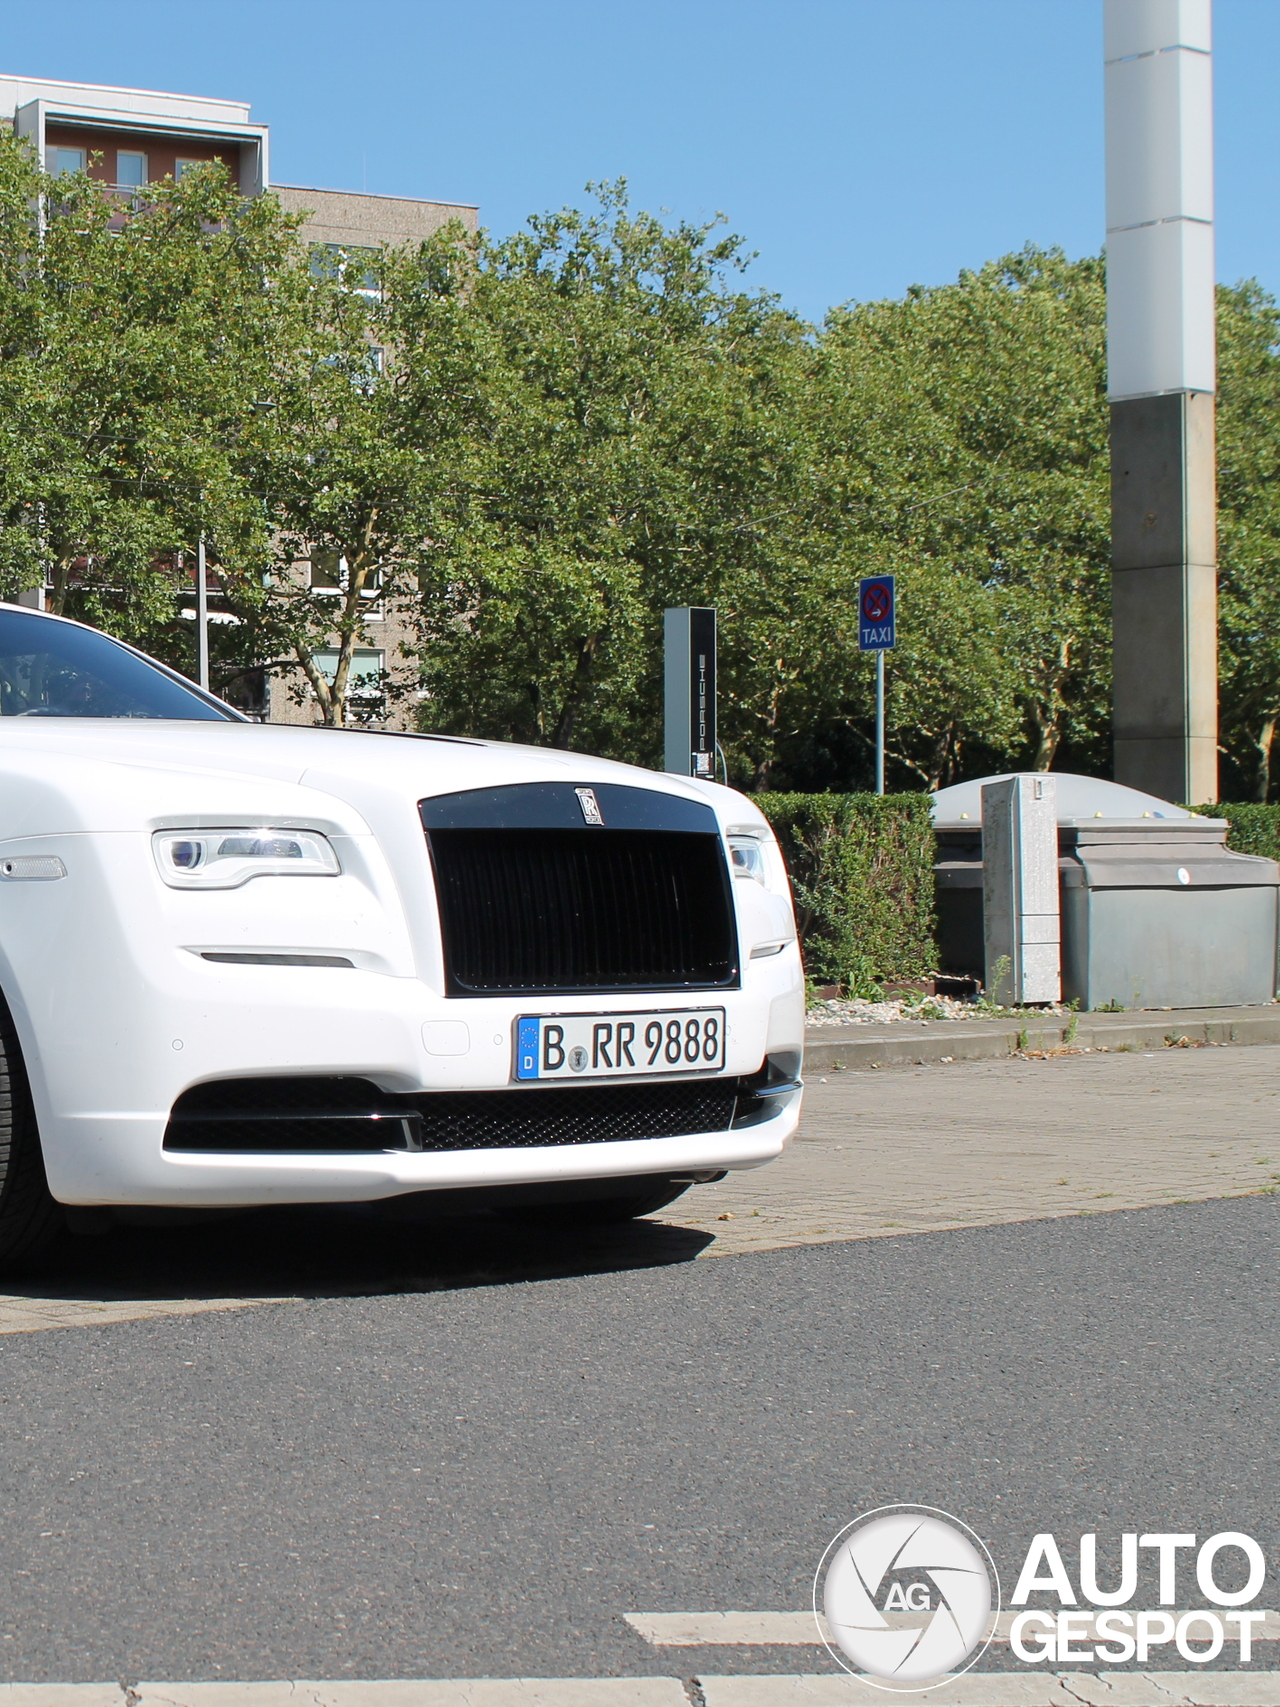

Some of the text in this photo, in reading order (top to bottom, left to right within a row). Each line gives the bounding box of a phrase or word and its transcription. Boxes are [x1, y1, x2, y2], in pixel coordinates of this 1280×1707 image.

[862, 626, 891, 644] TAXI
[543, 1017, 718, 1070] B RR 9888
[523, 1056, 533, 1070] D
